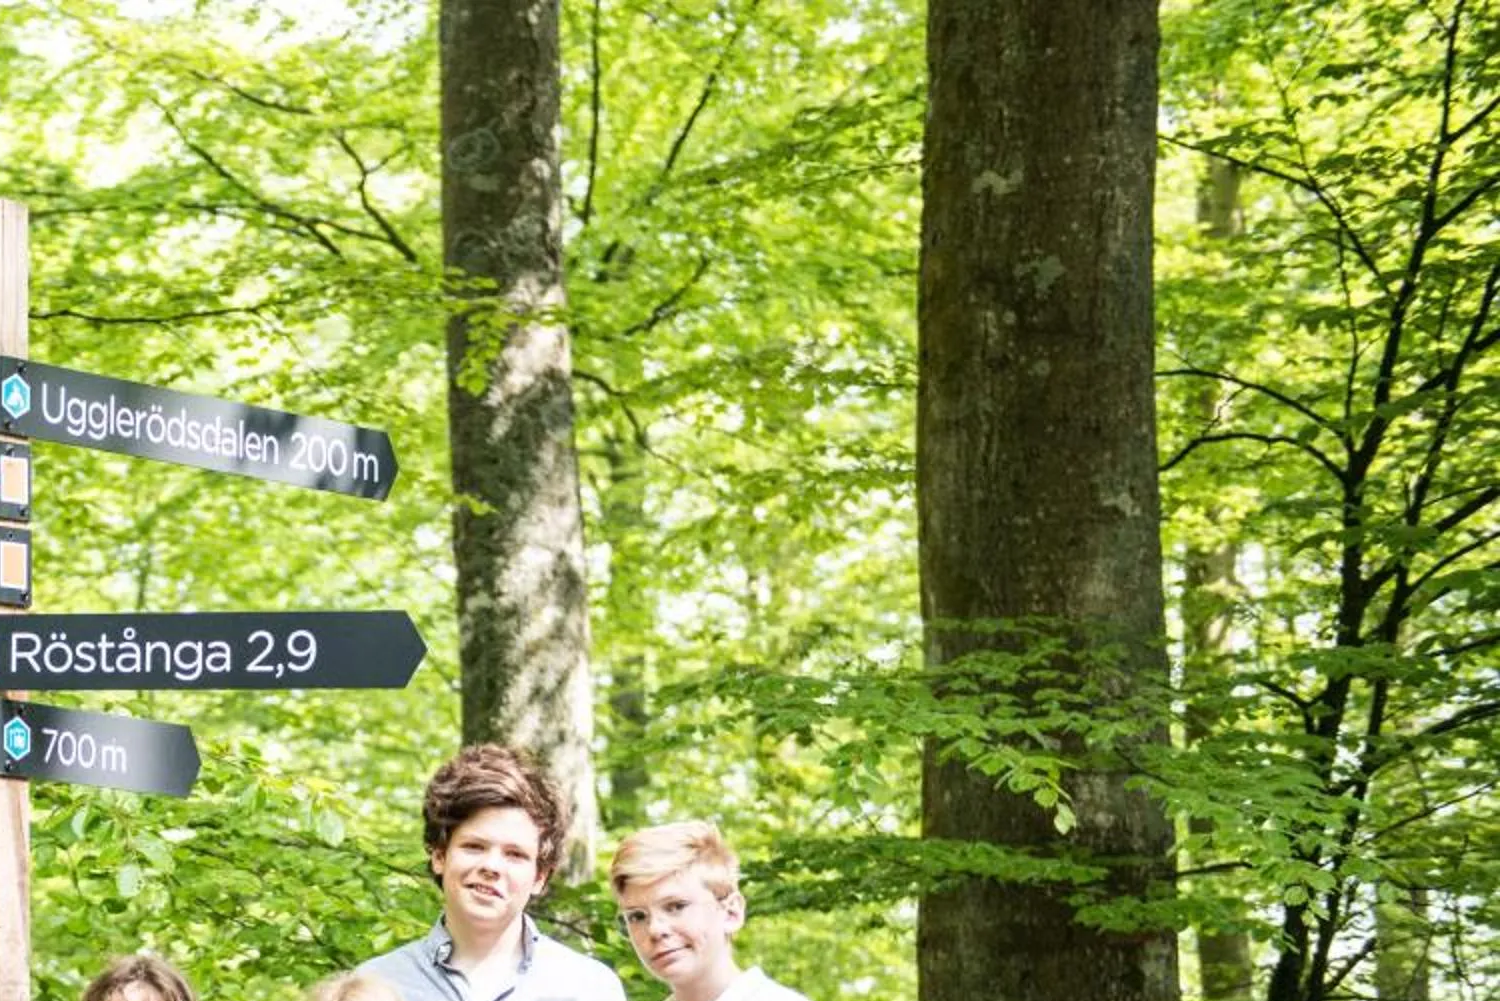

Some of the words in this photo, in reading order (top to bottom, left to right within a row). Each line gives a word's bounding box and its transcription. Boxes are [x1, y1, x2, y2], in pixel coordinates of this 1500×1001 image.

[41, 381, 280, 466] Ugglerödsdalen
[289, 431, 349, 478] 200
[352, 450, 380, 484] m
[10, 626, 232, 681] Röstånga
[245, 629, 317, 679] 2,9
[41, 727, 97, 769] 700
